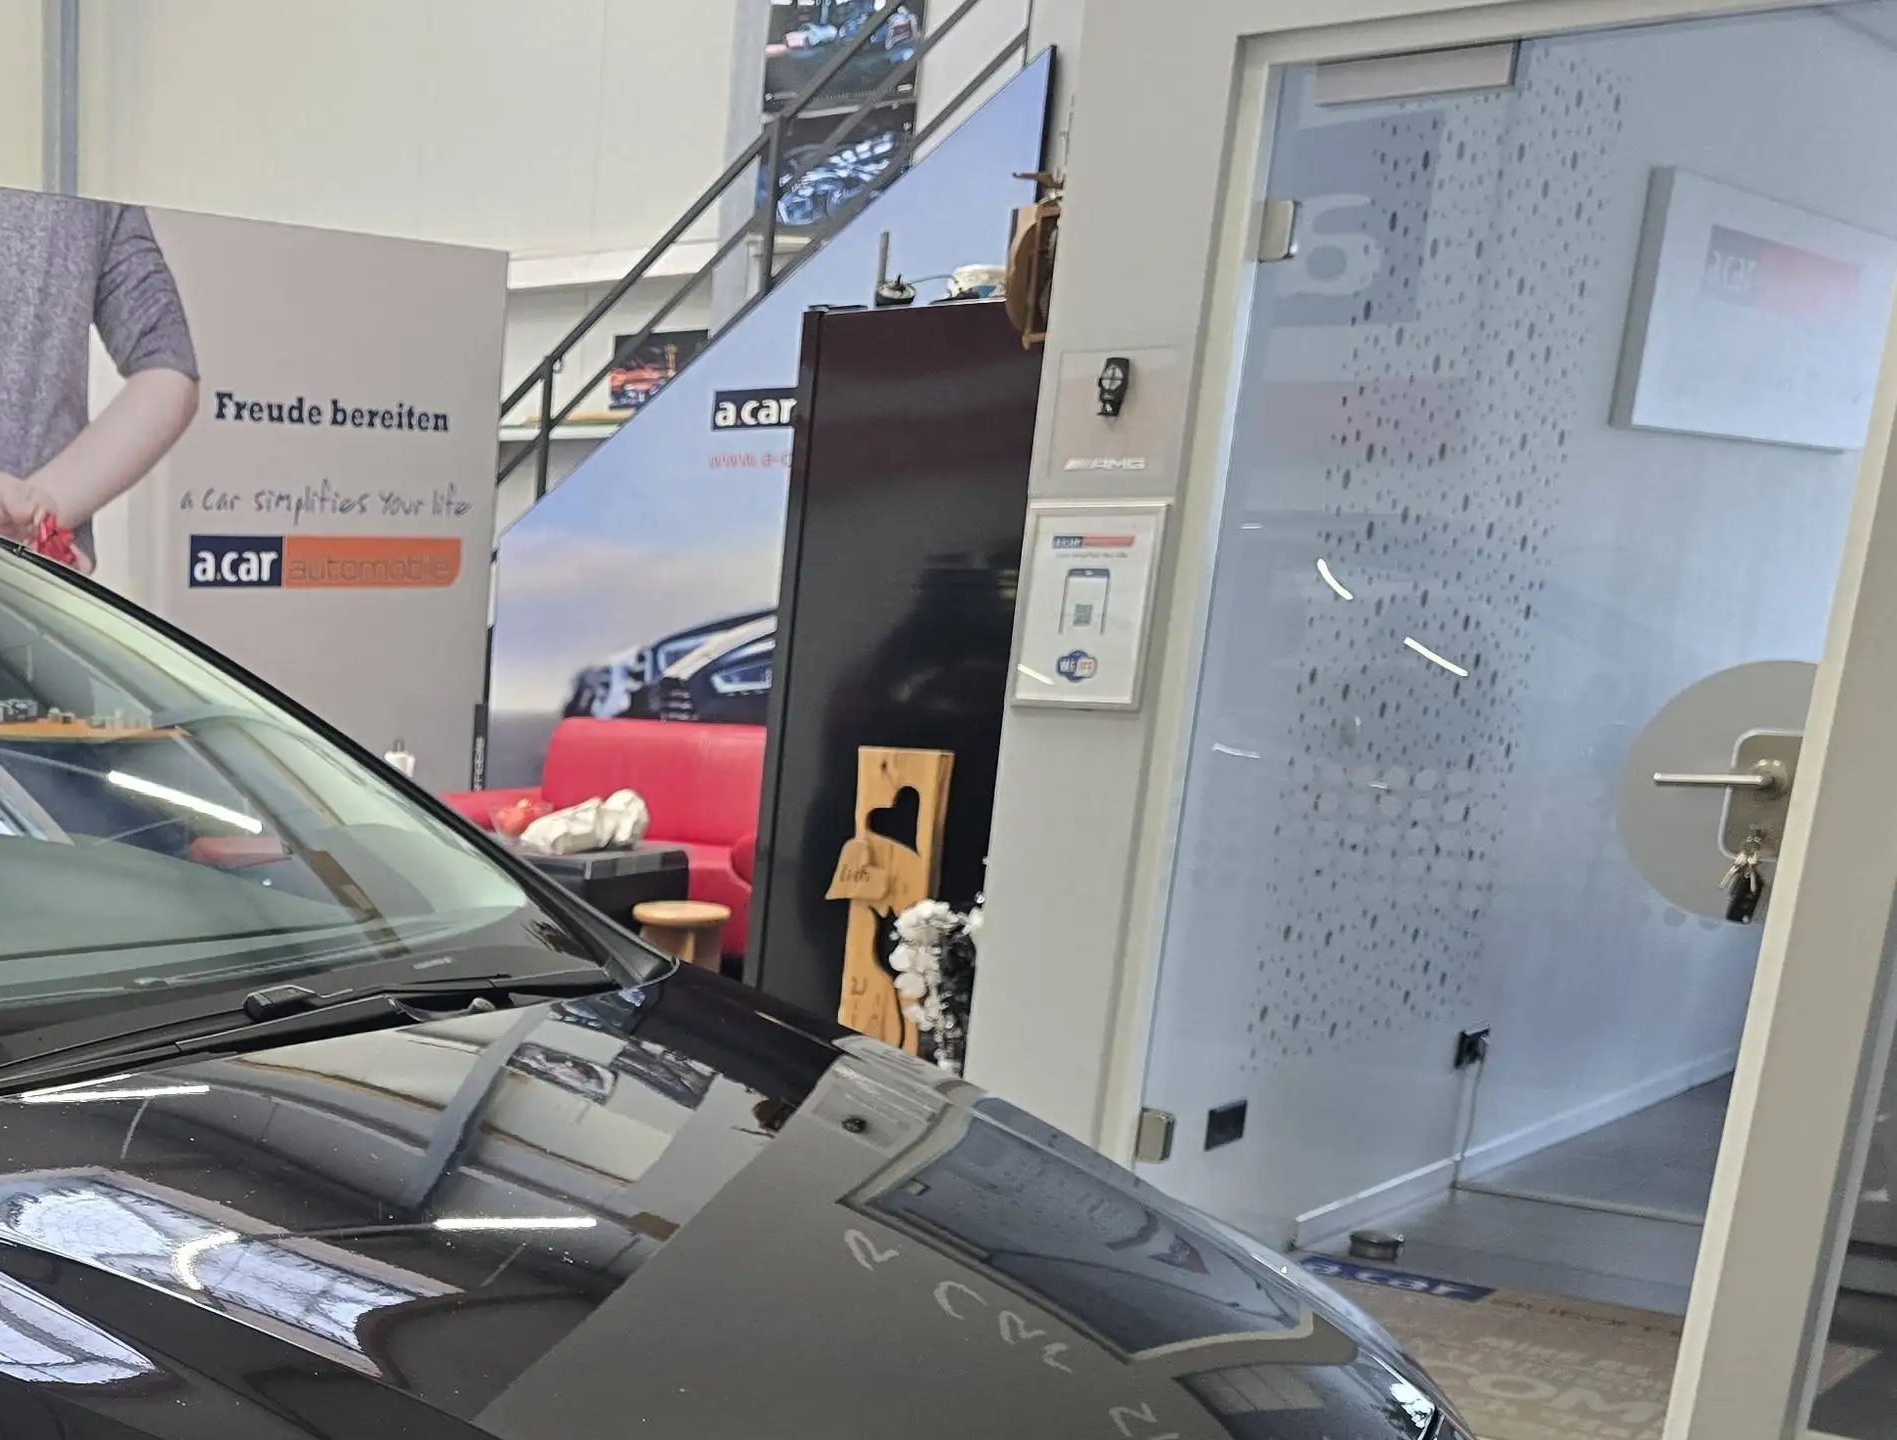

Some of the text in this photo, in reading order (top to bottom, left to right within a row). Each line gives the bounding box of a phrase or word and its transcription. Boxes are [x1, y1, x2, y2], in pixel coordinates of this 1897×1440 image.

[215, 392, 450, 433] Freude bereiten
[254, 478, 367, 526] simplifies
[432, 483, 473, 516] life
[288, 554, 453, 581] automobile
